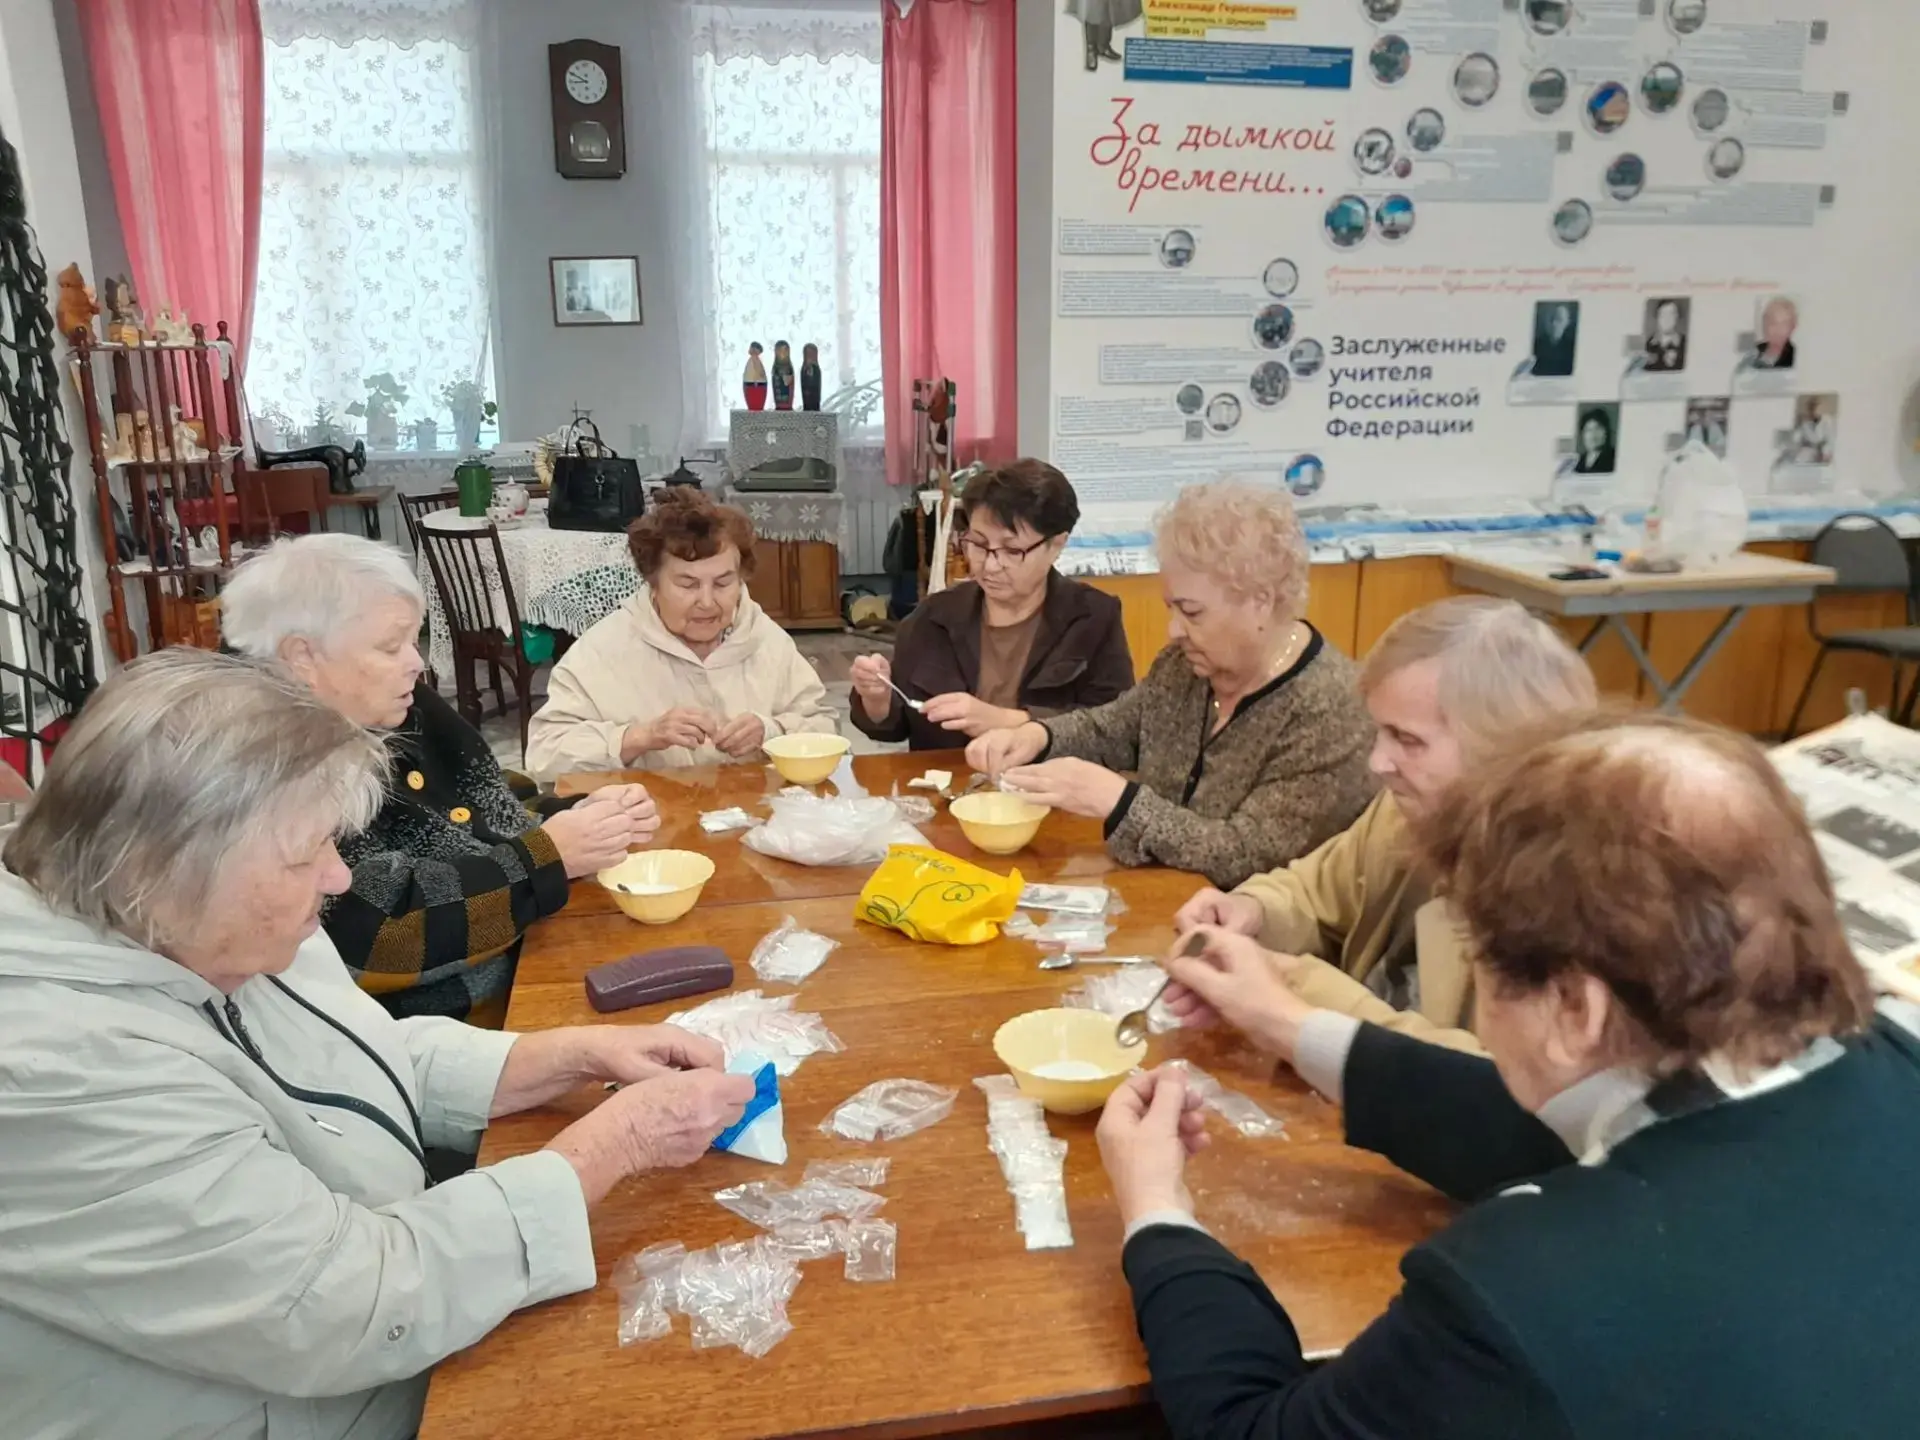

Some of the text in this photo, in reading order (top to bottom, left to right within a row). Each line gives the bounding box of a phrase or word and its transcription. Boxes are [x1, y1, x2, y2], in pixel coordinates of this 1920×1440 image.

[1091, 98, 1336, 165] За дымкой
[1118, 147, 1324, 213] времени...
[1331, 335, 1507, 359] Заслуженные
[1328, 365, 1433, 388] учителя
[1328, 387, 1480, 410] Российской
[1326, 416, 1474, 440] Федерации
